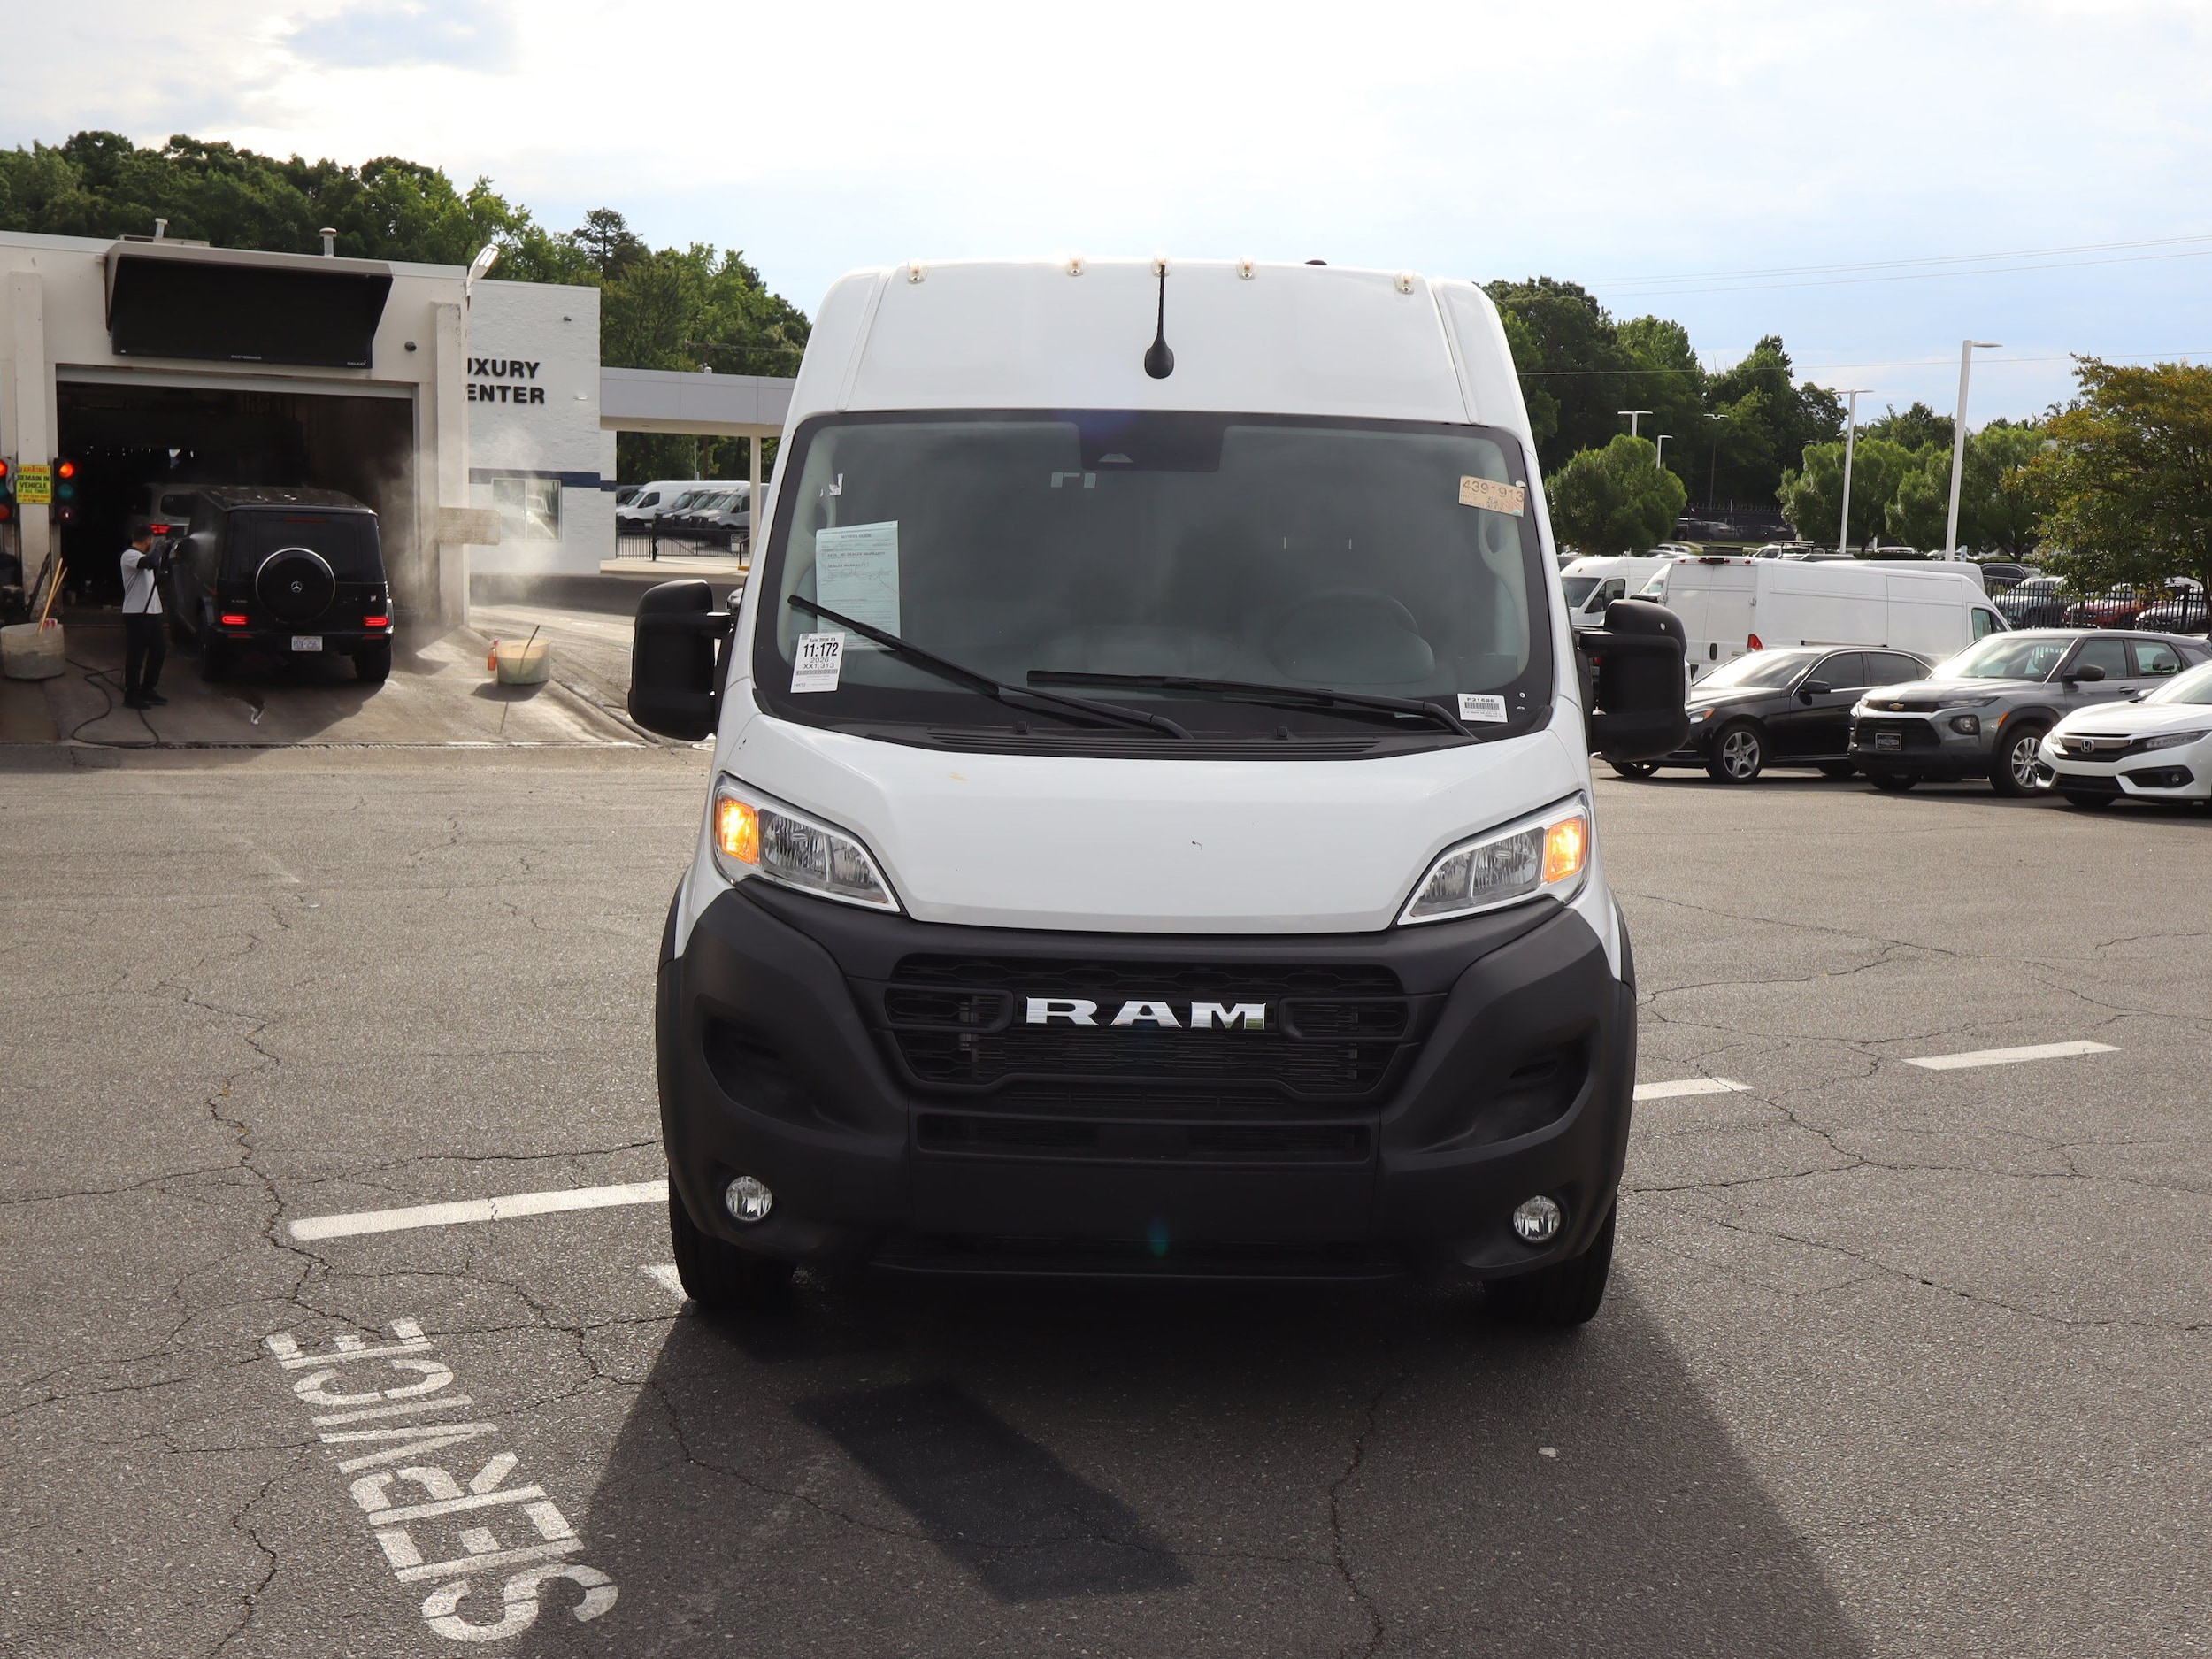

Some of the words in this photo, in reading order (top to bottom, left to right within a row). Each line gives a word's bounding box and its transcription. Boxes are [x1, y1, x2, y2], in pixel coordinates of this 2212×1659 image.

[467, 357, 540, 379] XURY
[803, 642, 840, 657] 11:172
[1025, 995, 1267, 1029] RAM
[265, 1317, 619, 1645] SERVICE
